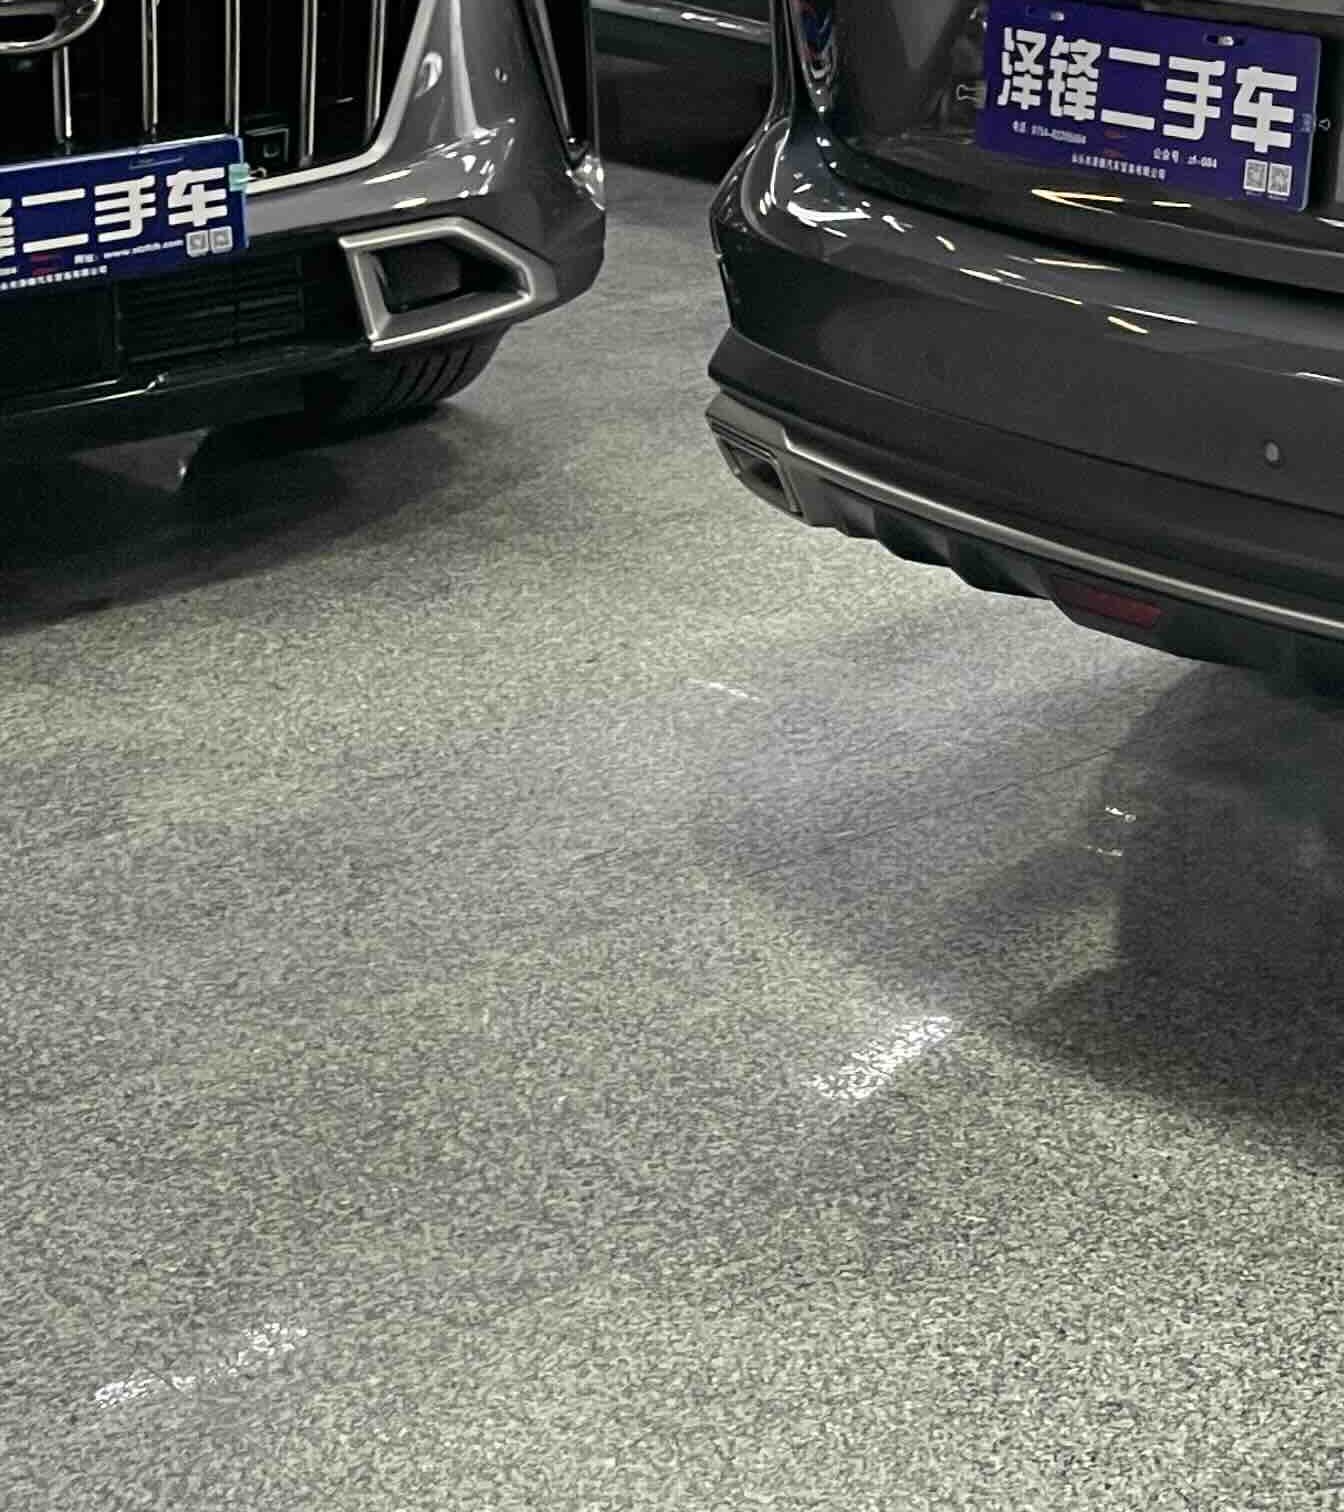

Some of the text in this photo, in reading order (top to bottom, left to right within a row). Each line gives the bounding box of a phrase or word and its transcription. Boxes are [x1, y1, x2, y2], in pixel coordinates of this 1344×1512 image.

[997, 26, 1298, 153] 泽锋二手车
[0, 167, 228, 259] 二手车
